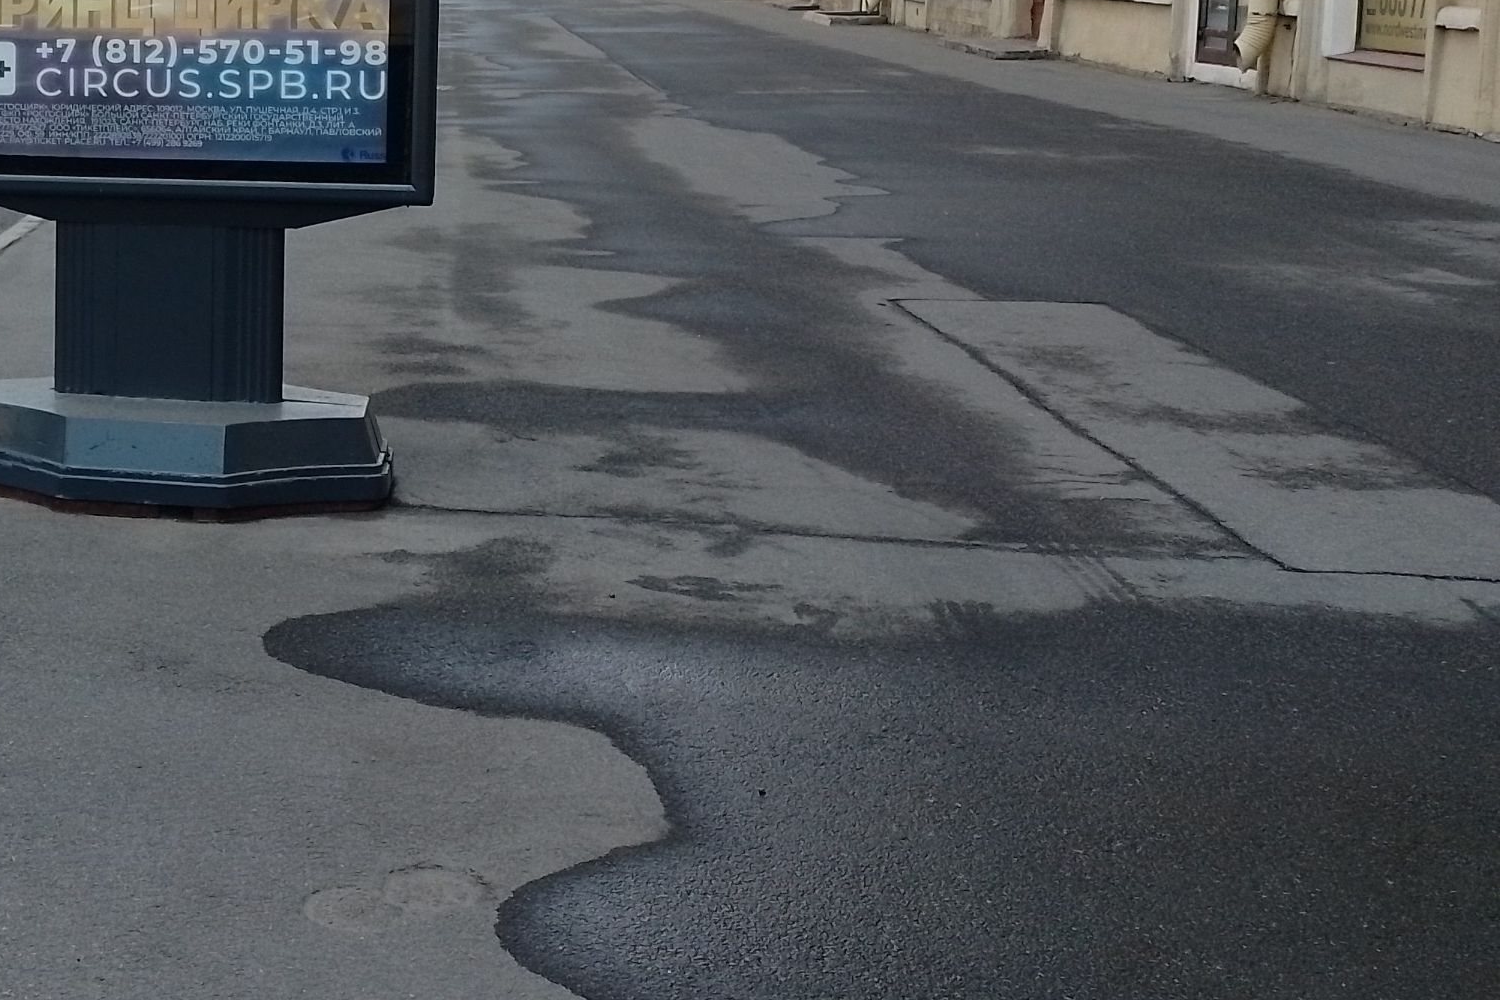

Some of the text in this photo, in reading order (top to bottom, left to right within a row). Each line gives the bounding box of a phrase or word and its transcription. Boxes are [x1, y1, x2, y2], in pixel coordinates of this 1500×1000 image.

[35, 36, 387, 68] +7 (812)-570-51-98
[35, 67, 387, 100] CIRCUS.SPB.RU
